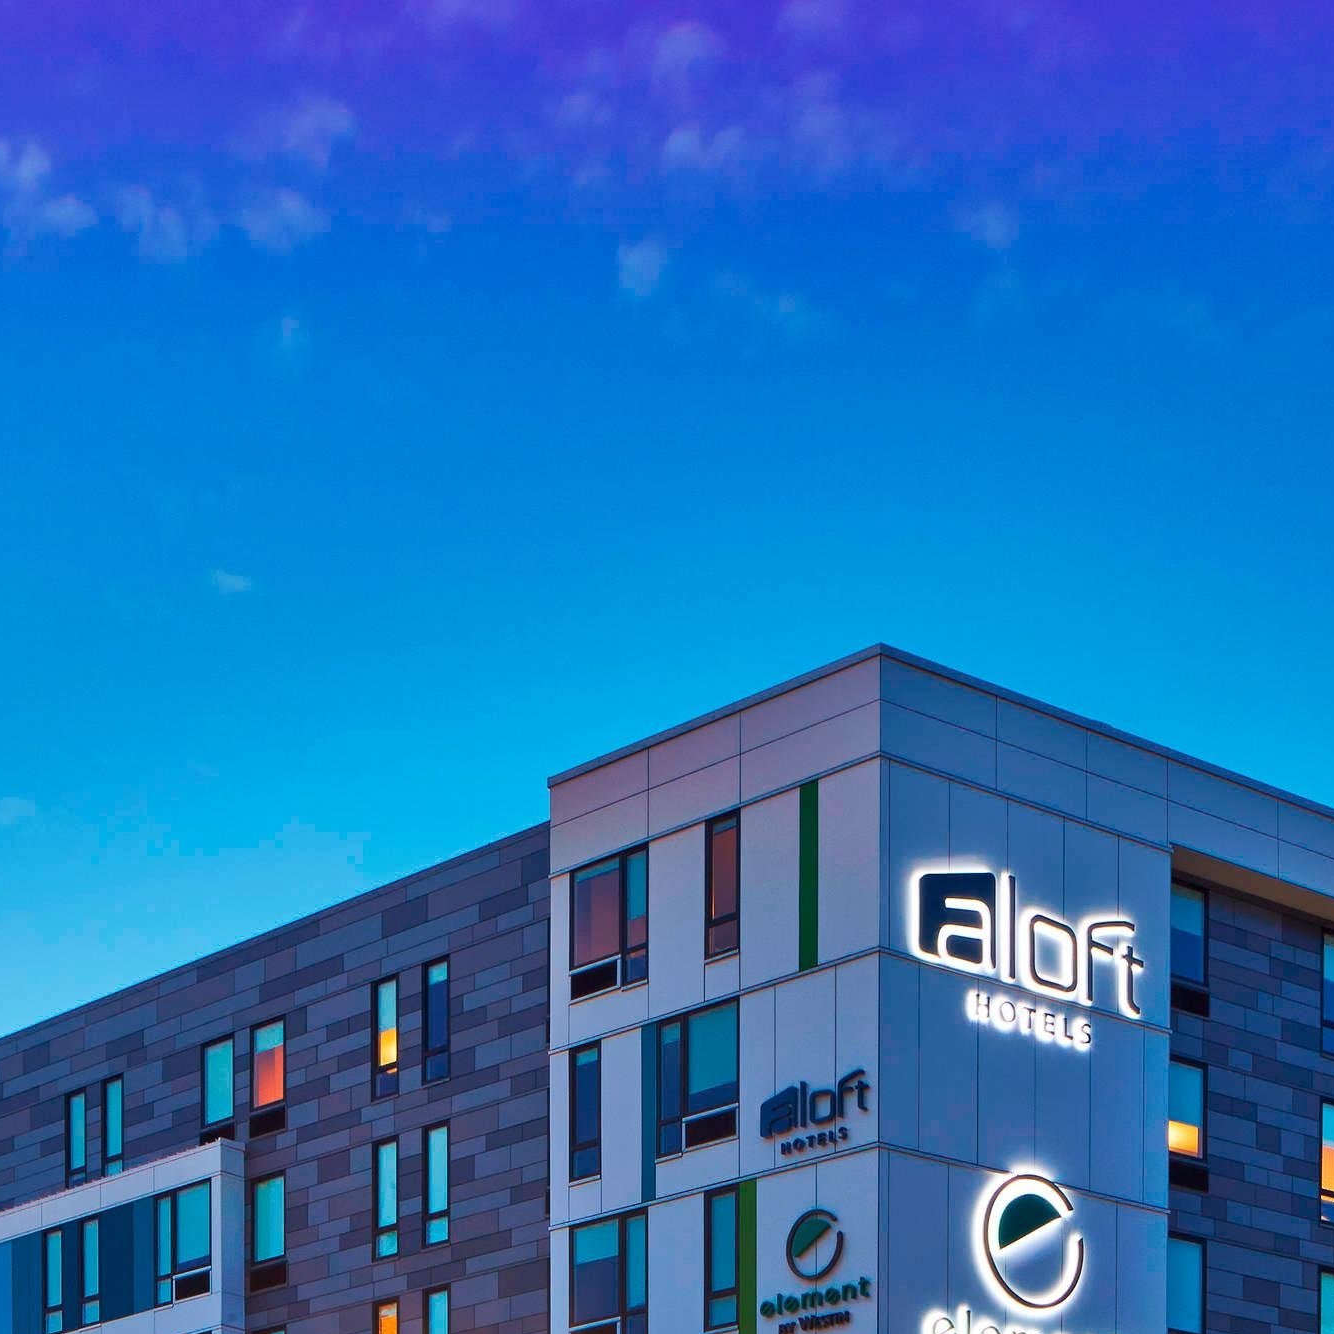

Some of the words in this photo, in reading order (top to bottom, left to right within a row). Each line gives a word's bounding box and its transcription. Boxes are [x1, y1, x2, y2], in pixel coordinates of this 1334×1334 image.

[915, 870, 1145, 1017] aloft
[973, 990, 1093, 1045] HOTELS
[760, 1068, 871, 1138] aloft
[780, 1126, 849, 1155] HOTELS
[759, 1276, 871, 1319] element
